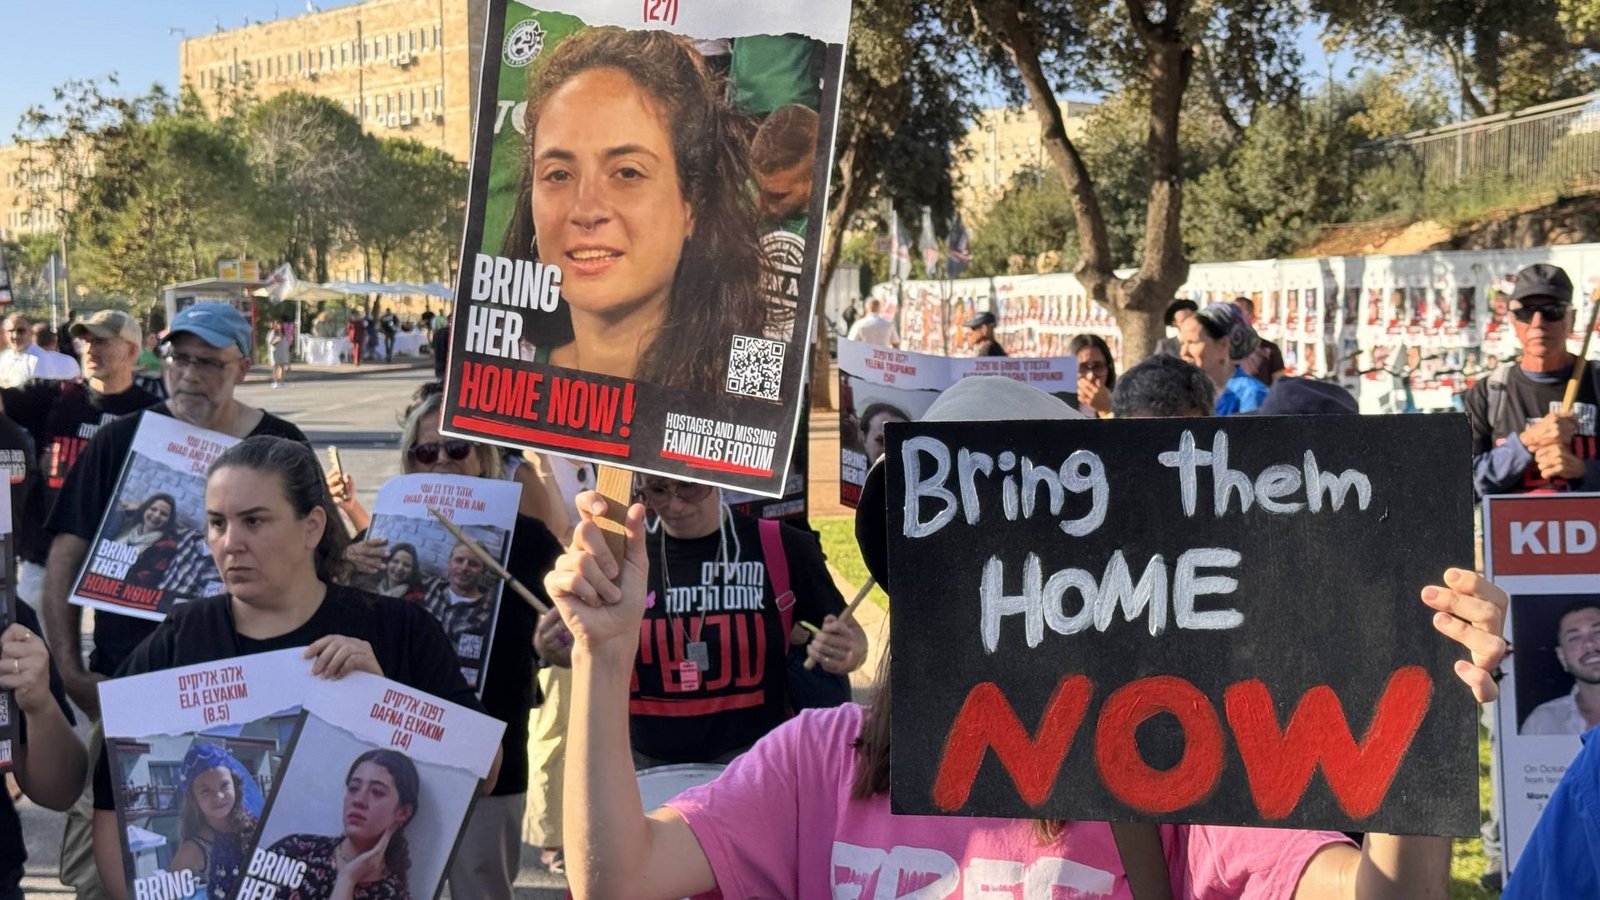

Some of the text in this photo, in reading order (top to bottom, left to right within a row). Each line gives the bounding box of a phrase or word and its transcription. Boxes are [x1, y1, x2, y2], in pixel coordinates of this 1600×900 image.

[644, 0, 678, 25] (27)
[471, 253, 562, 312] BRING
[465, 305, 523, 360] HER
[458, 360, 635, 438] HOME NOW!
[665, 412, 777, 447] HOSTAGES AND MISSING
[663, 428, 774, 471] FAMILIES FORUM
[842, 448, 868, 470] BRING
[902, 429, 1372, 538] Bring them
[423, 495, 438, 504] AND
[456, 498, 471, 508] BEN
[471, 501, 486, 512] AMI
[98, 538, 139, 566] BRING
[1510, 520, 1600, 555] KID
[91, 556, 130, 581] THEM
[83, 573, 164, 605] HOME NOW!
[665, 586, 765, 613] אותם הביתה
[630, 613, 766, 692] עכשי
[178, 665, 244, 691] אלה אליקים
[180, 683, 248, 709] ELA ELYAKIM
[383, 688, 445, 723] דפנה אליקים
[203, 703, 230, 725] (8.5)
[370, 703, 445, 742] DAFNA ELYAKIM
[391, 729, 413, 751] (14)
[932, 664, 1434, 820] NOW
[134, 868, 196, 900] BRING
[248, 848, 307, 889] BRING
[236, 876, 277, 900] HER
